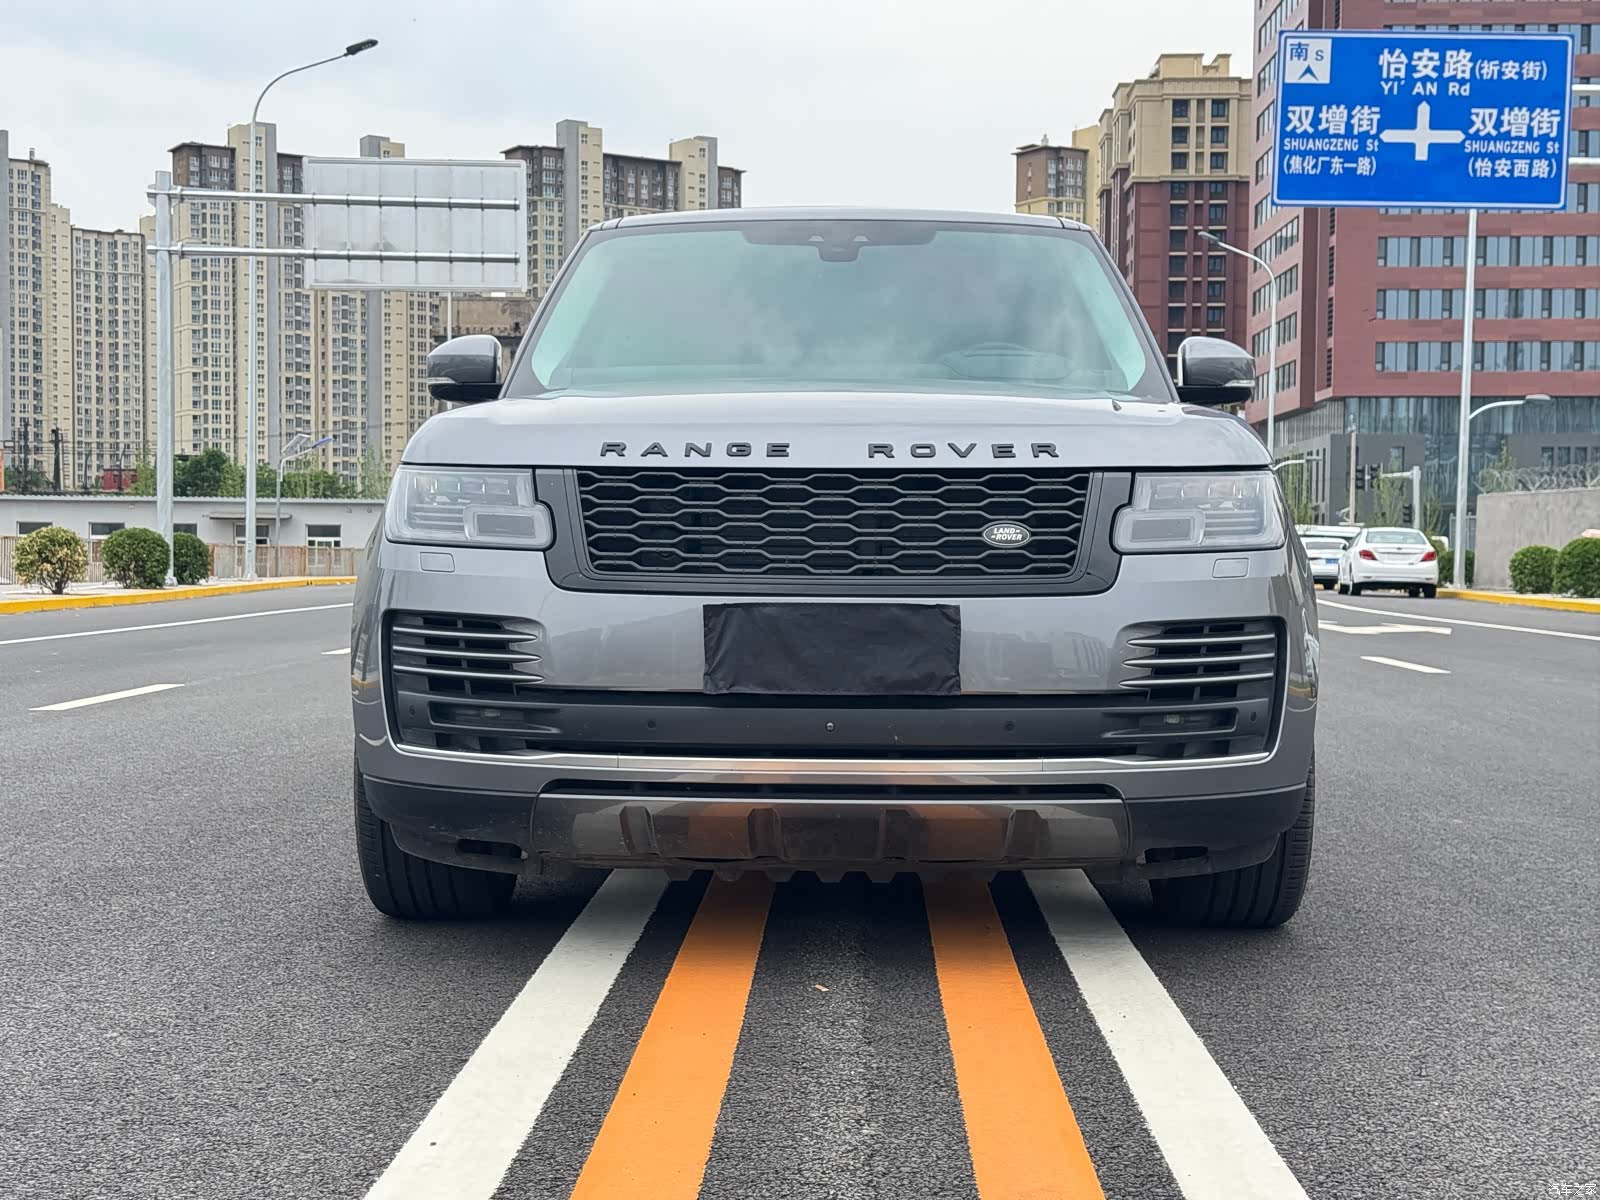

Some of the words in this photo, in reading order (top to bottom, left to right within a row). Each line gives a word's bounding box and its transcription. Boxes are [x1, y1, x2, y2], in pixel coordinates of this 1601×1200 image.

[1289, 43, 1309, 62] 南
[1315, 50, 1325, 62] S
[1379, 48, 1473, 79] 怡安路
[1475, 60, 1548, 81] (祈安街)
[1412, 81, 1437, 96] AN
[1448, 81, 1471, 97] Rd
[1285, 104, 1381, 135] 双增街
[1468, 107, 1561, 138] 双增街
[1283, 138, 1359, 152] SHUANGZENG
[1366, 139, 1379, 152] St
[1464, 140, 1540, 154] SHUANGZENG
[1546, 142, 1560, 155] St
[1283, 154, 1377, 176] (焦化厂东一路)
[1468, 157, 1557, 179] (怡安西路)
[600, 441, 791, 458] RANGE
[868, 442, 1060, 459] ROVER
